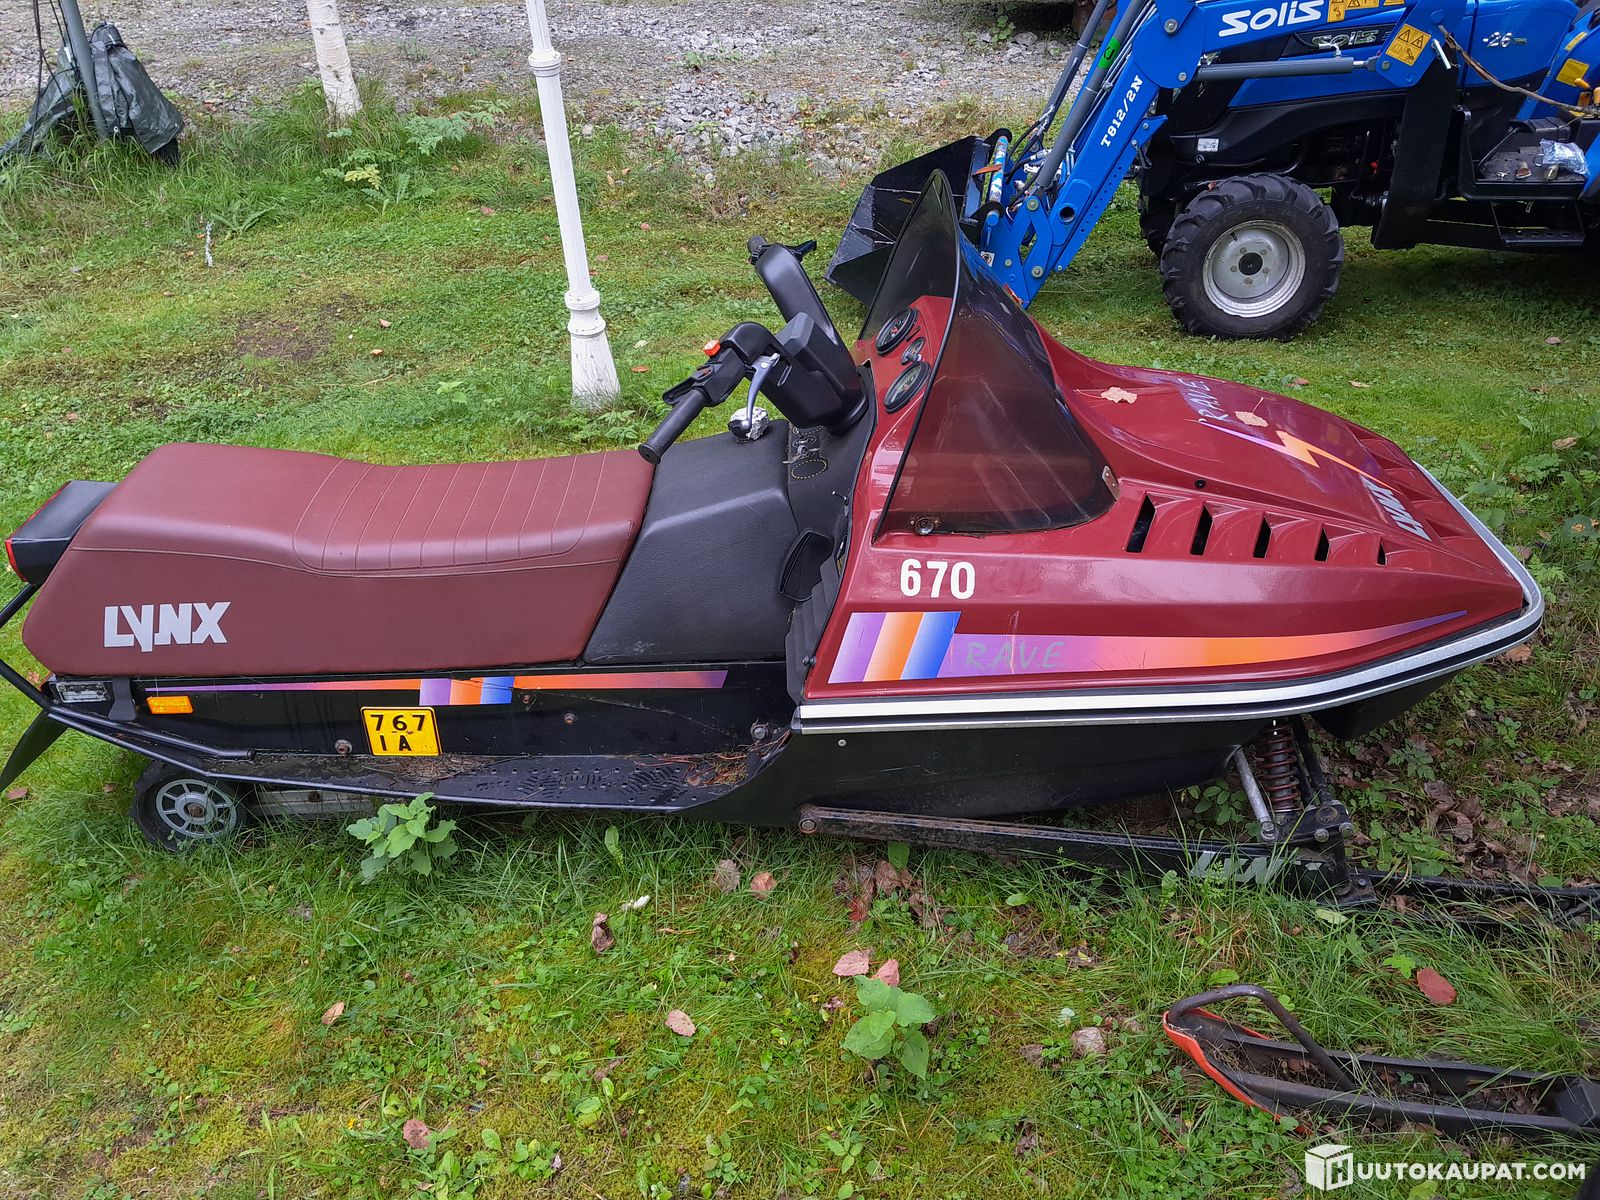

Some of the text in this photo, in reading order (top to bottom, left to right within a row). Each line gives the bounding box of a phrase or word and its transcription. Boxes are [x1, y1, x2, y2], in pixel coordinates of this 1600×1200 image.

[1100, 75, 1143, 147] T812/2N
[1358, 474, 1433, 542] LYNX
[900, 558, 976, 600] 670
[104, 601, 231, 652] LYNX
[370, 713, 426, 731] 767
[379, 735, 412, 752] IA
